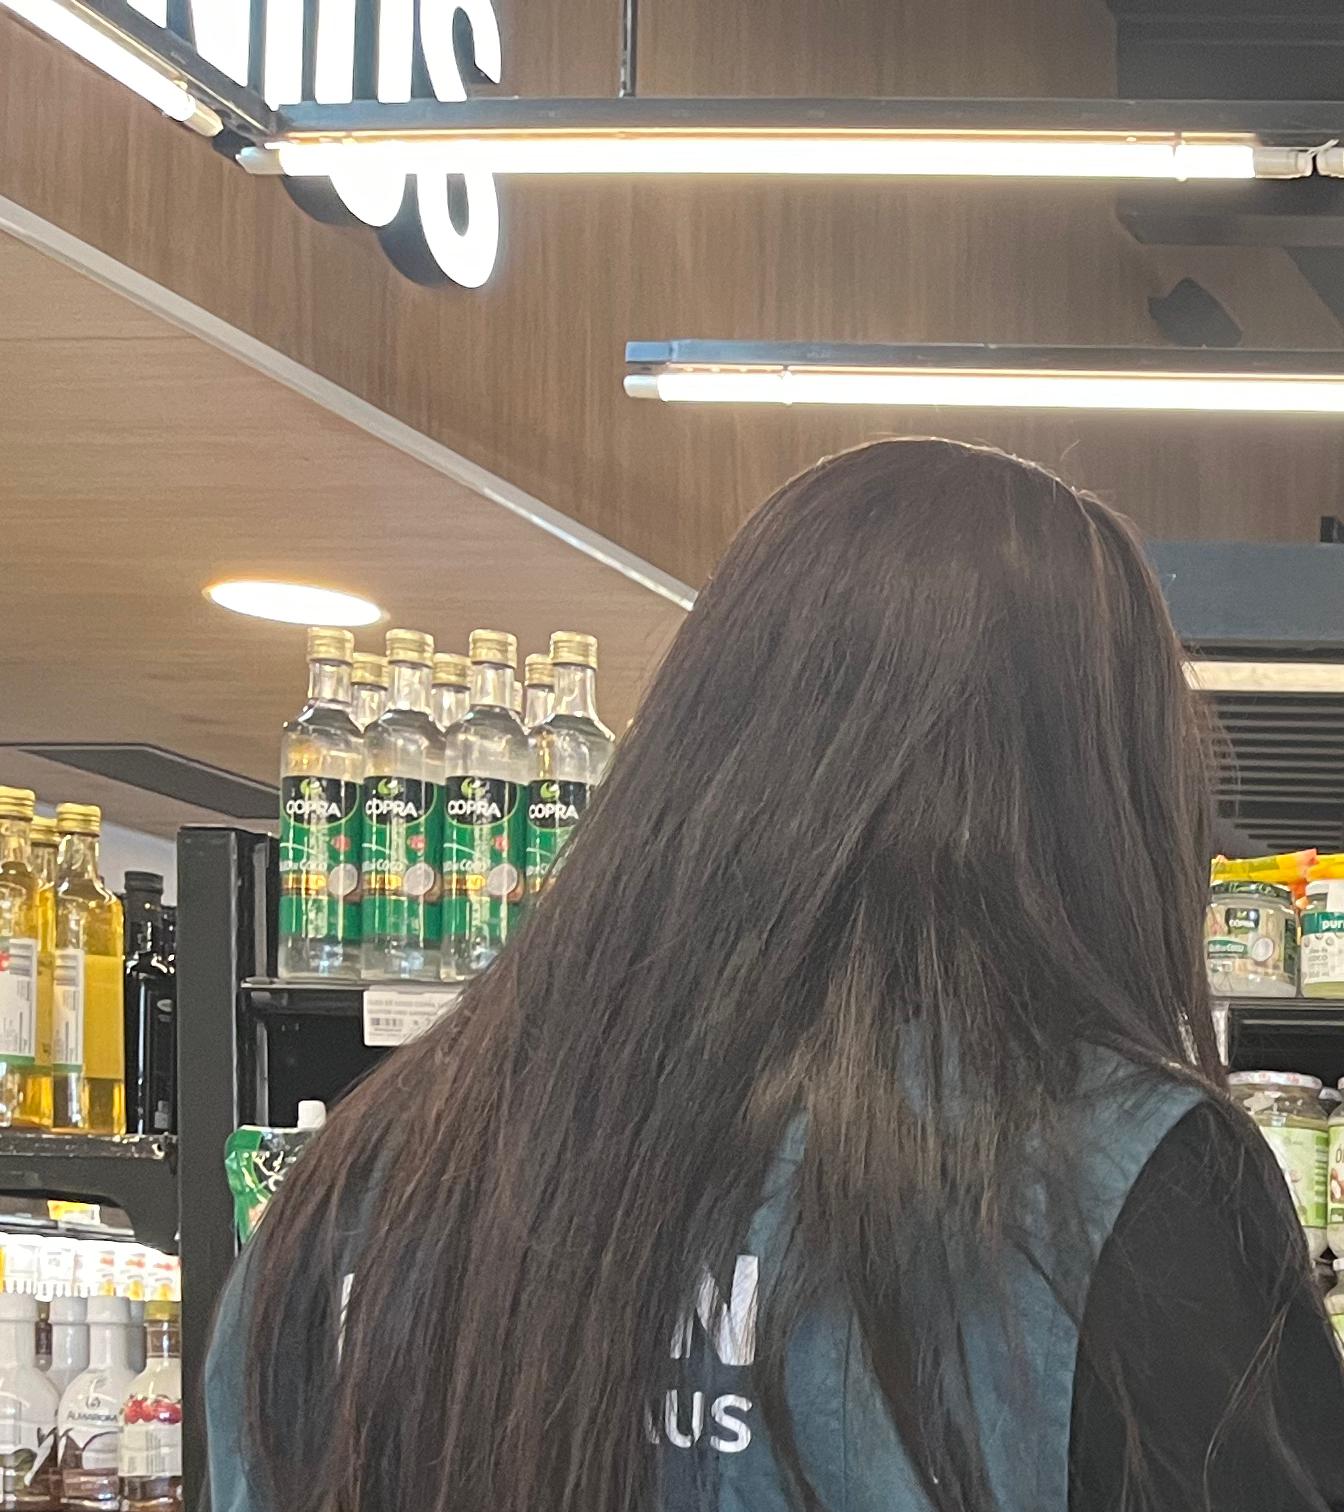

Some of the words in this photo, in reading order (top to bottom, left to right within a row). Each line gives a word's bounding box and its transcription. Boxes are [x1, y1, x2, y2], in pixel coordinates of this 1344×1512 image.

[286, 800, 341, 817] COPRA
[365, 800, 417, 817] COPRA
[448, 800, 501, 817] COPRA
[529, 804, 578, 820] COPRA
